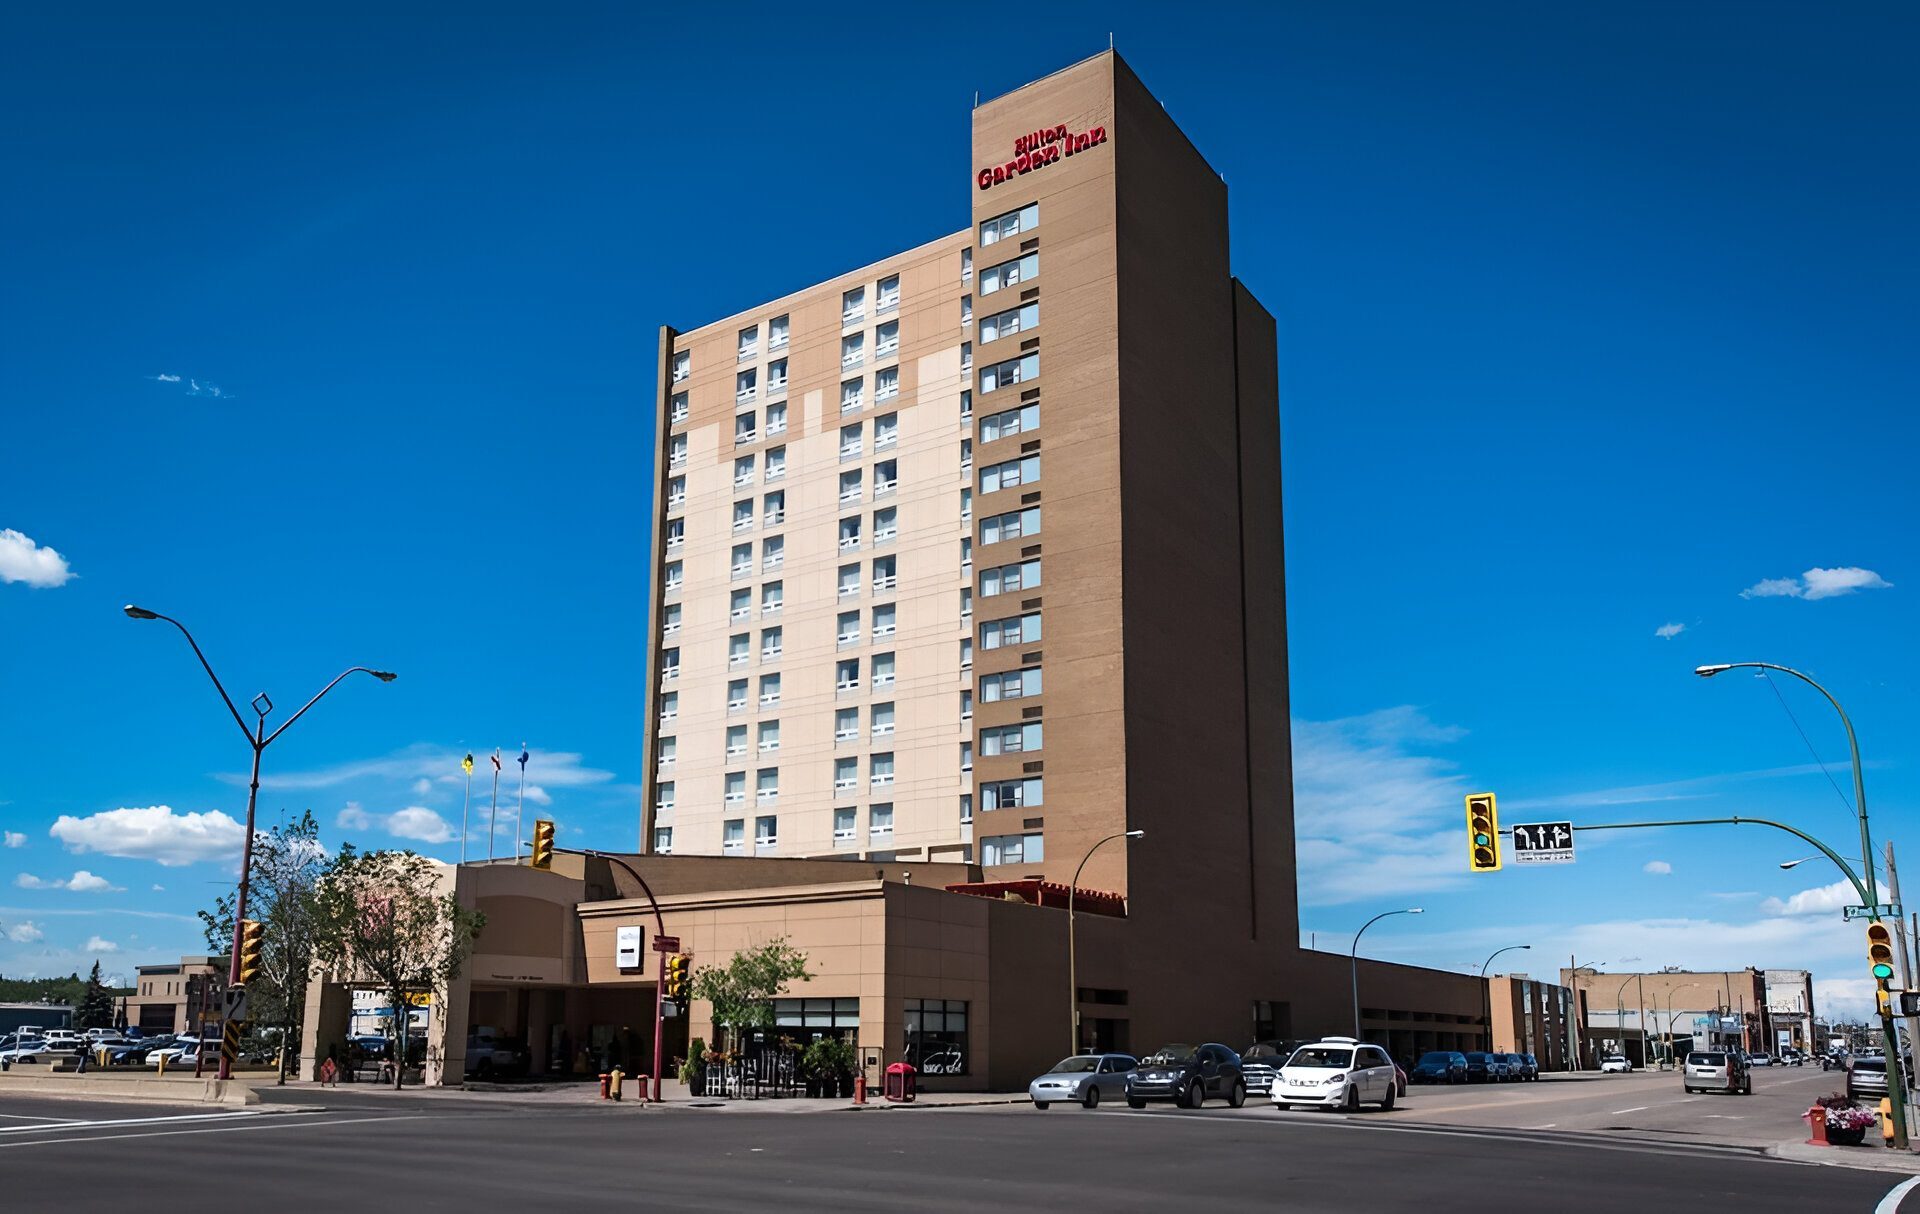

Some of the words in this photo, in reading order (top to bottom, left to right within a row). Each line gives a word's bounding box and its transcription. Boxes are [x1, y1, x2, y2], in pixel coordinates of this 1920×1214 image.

[978, 145, 1060, 190] Garden
[1064, 126, 1107, 157] Inn
[1014, 124, 1068, 158] Hilton
